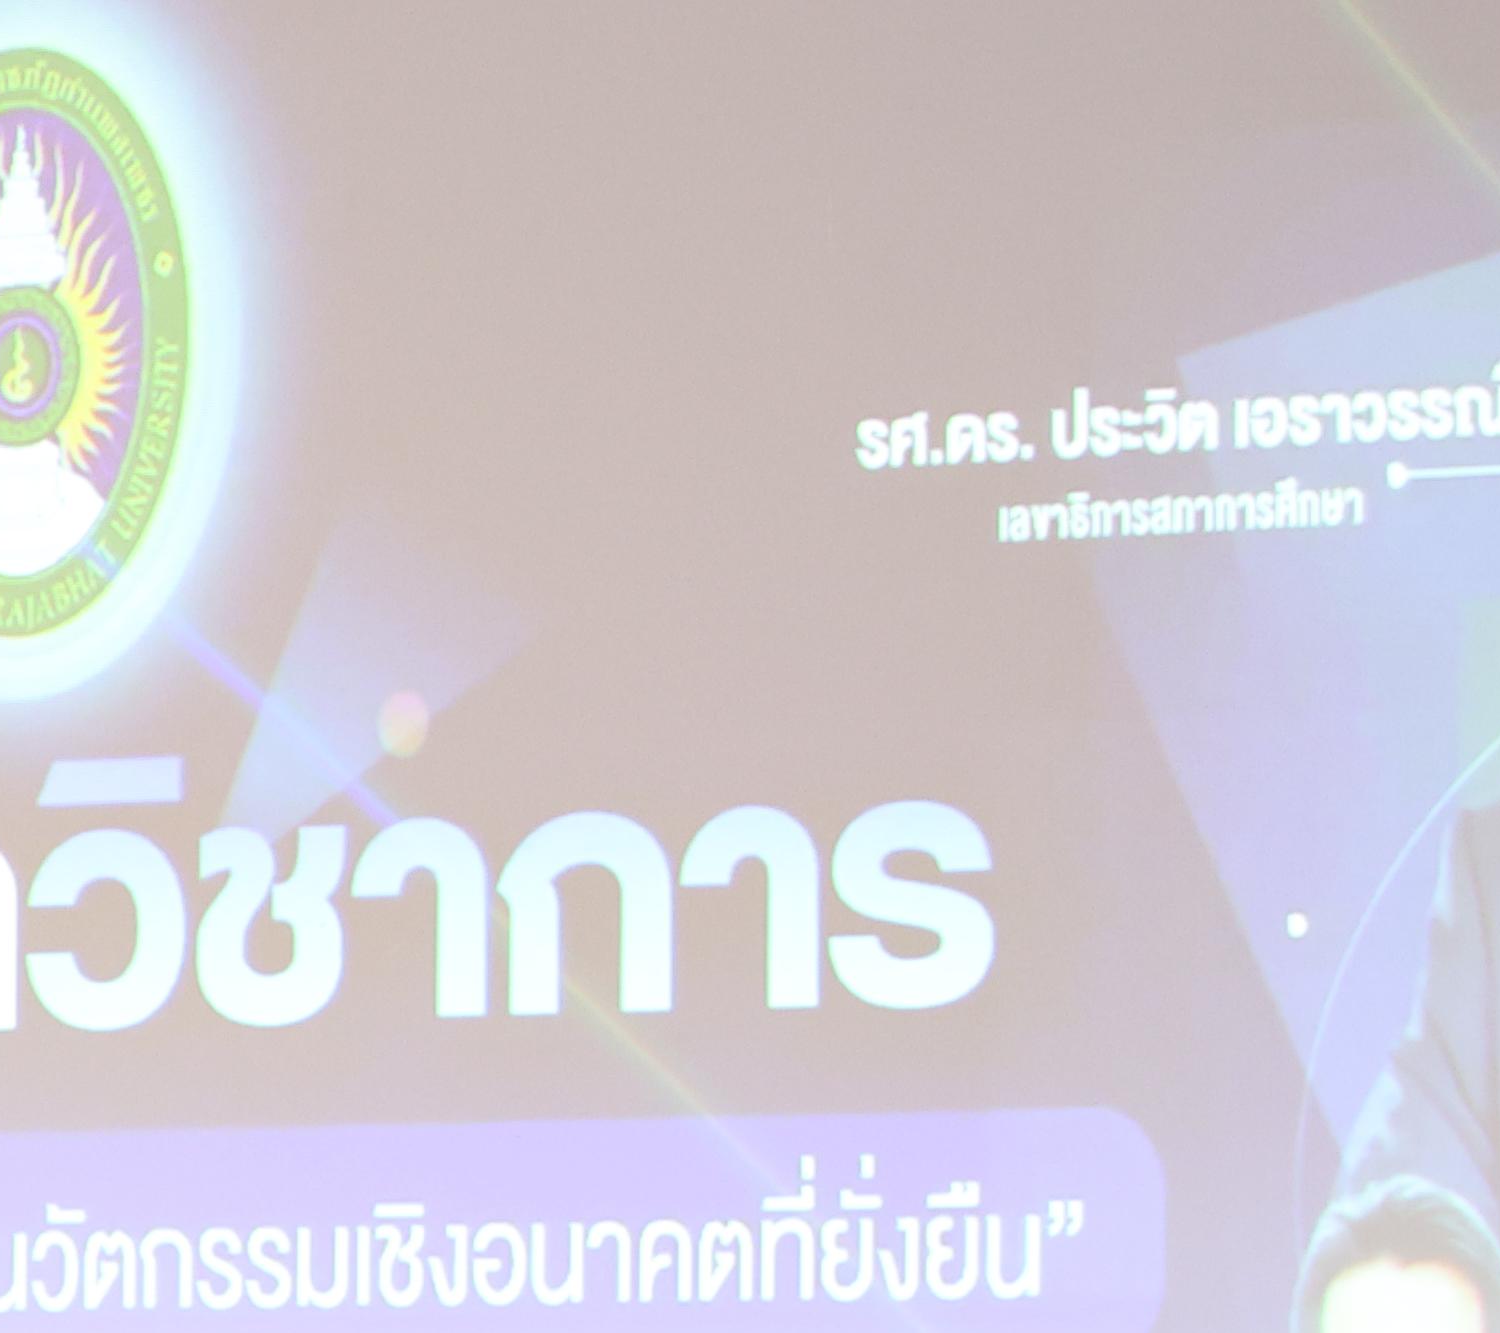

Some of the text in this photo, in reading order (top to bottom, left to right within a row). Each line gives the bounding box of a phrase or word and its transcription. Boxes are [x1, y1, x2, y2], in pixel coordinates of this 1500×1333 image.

[110, 337, 182, 542] UNIVERSITY
[855, 411, 1035, 471] รศ.ดร.
[1051, 387, 1219, 460] ประวิต
